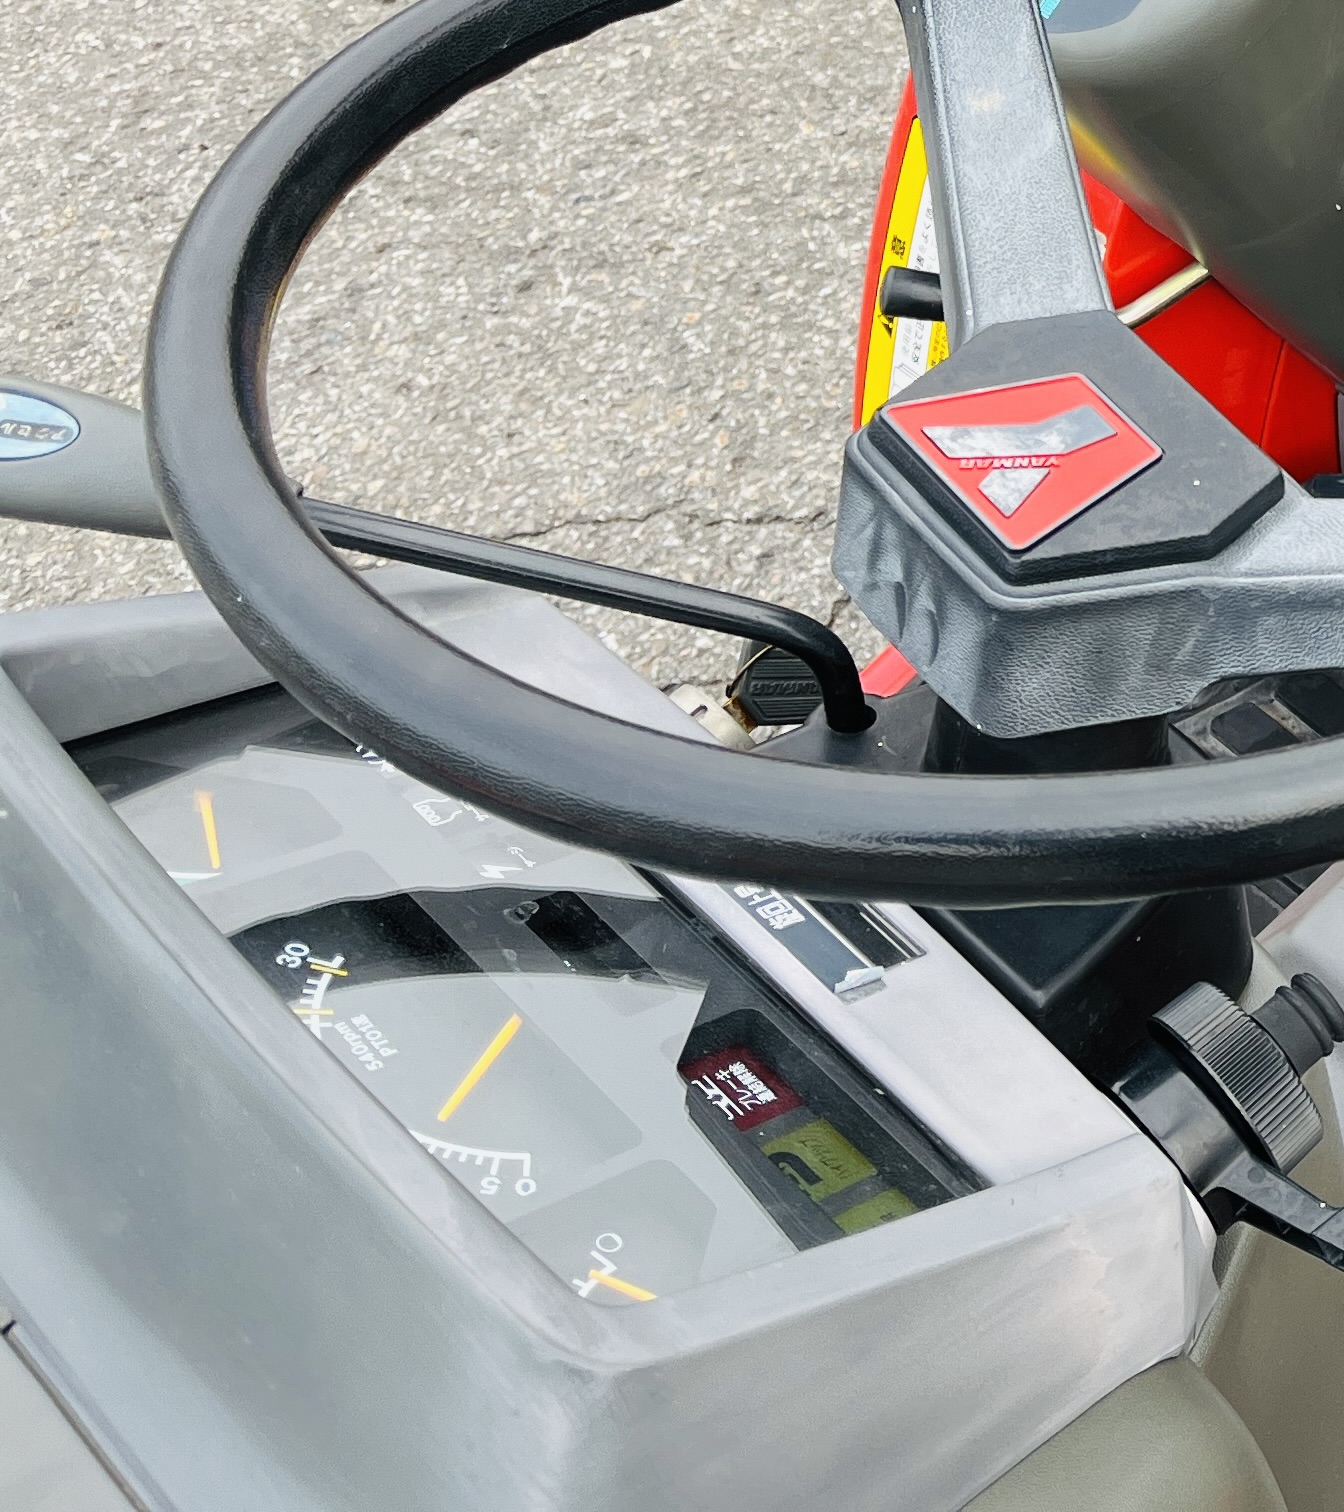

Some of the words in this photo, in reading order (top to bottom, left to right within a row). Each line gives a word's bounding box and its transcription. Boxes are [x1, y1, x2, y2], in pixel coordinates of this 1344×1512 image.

[0, 421, 66, 442] アクセル
[959, 456, 1060, 469] YANMAR
[275, 941, 311, 970] 30
[333, 1020, 386, 1072] 540rpm
[714, 1068, 763, 1111] ブレーキ
[479, 1176, 503, 1196] 5
[514, 1178, 537, 1197] 0
